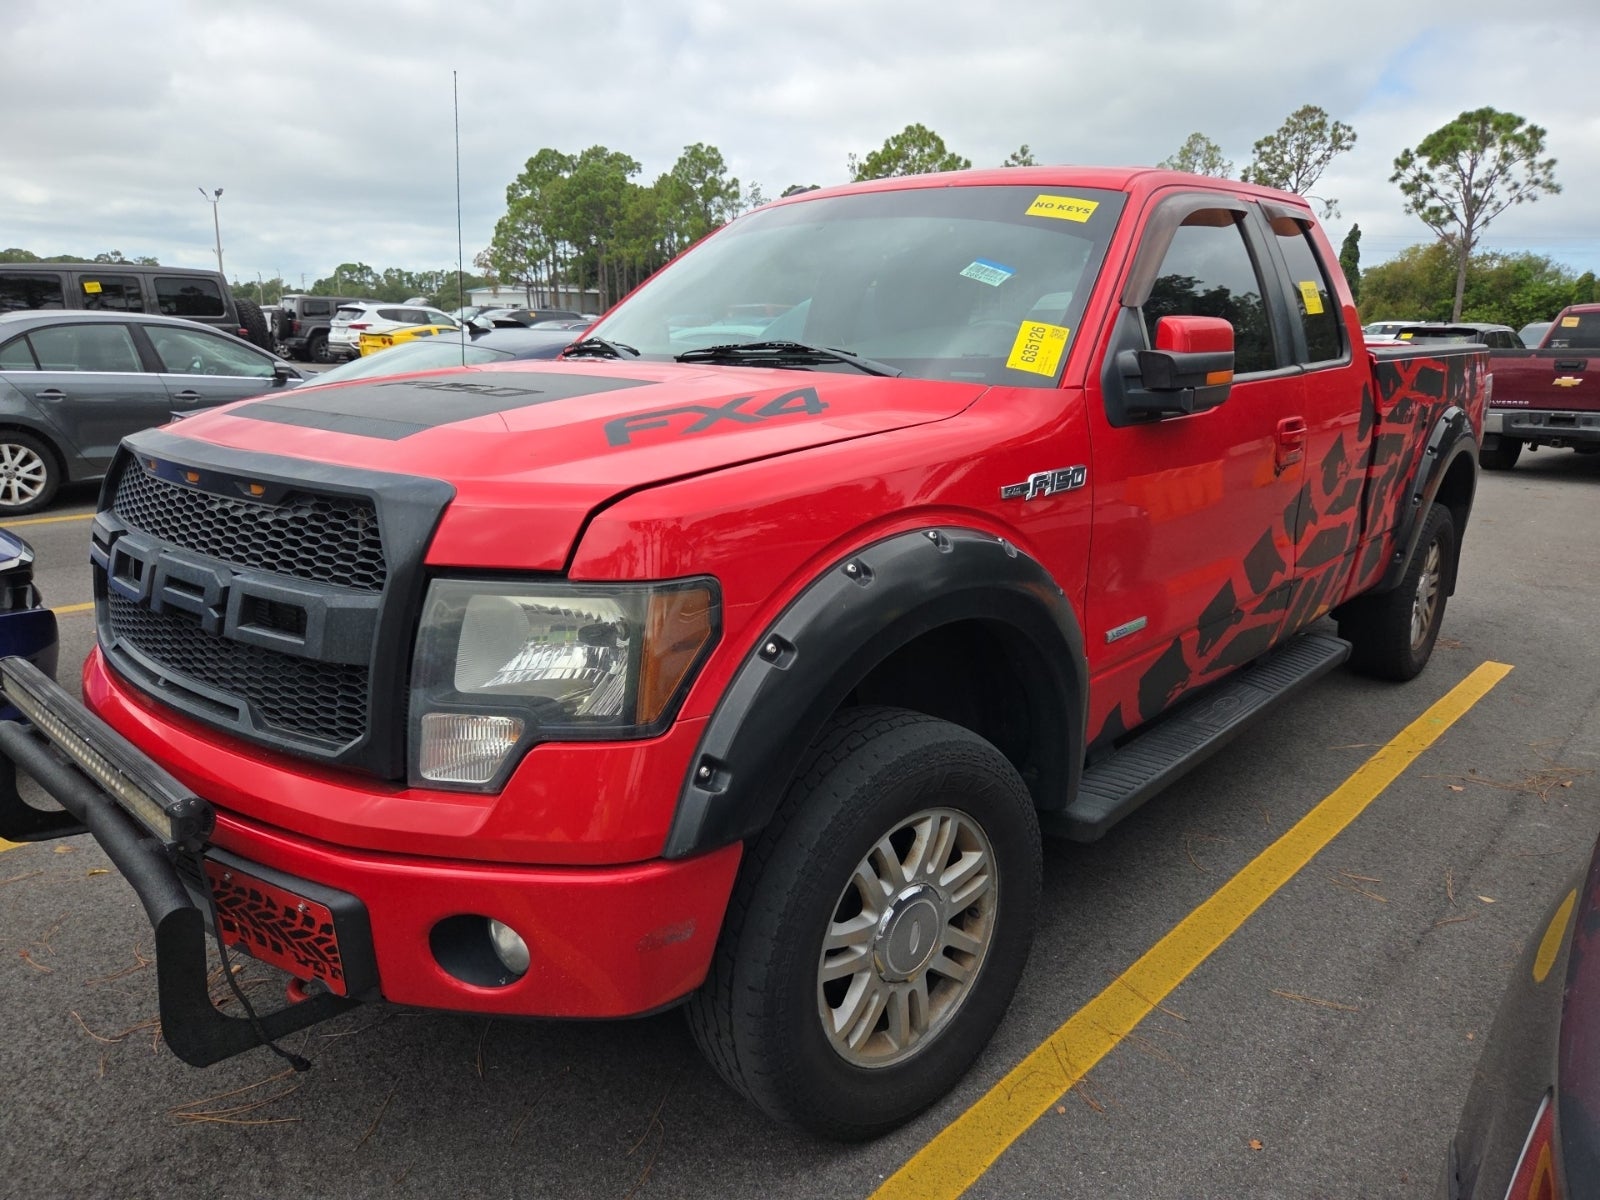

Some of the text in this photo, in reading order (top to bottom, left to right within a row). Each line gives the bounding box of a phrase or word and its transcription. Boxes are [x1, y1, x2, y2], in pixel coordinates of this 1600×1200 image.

[1034, 201, 1092, 214] NO KEYS
[1021, 326, 1046, 363] 635126
[604, 386, 829, 447] FX4
